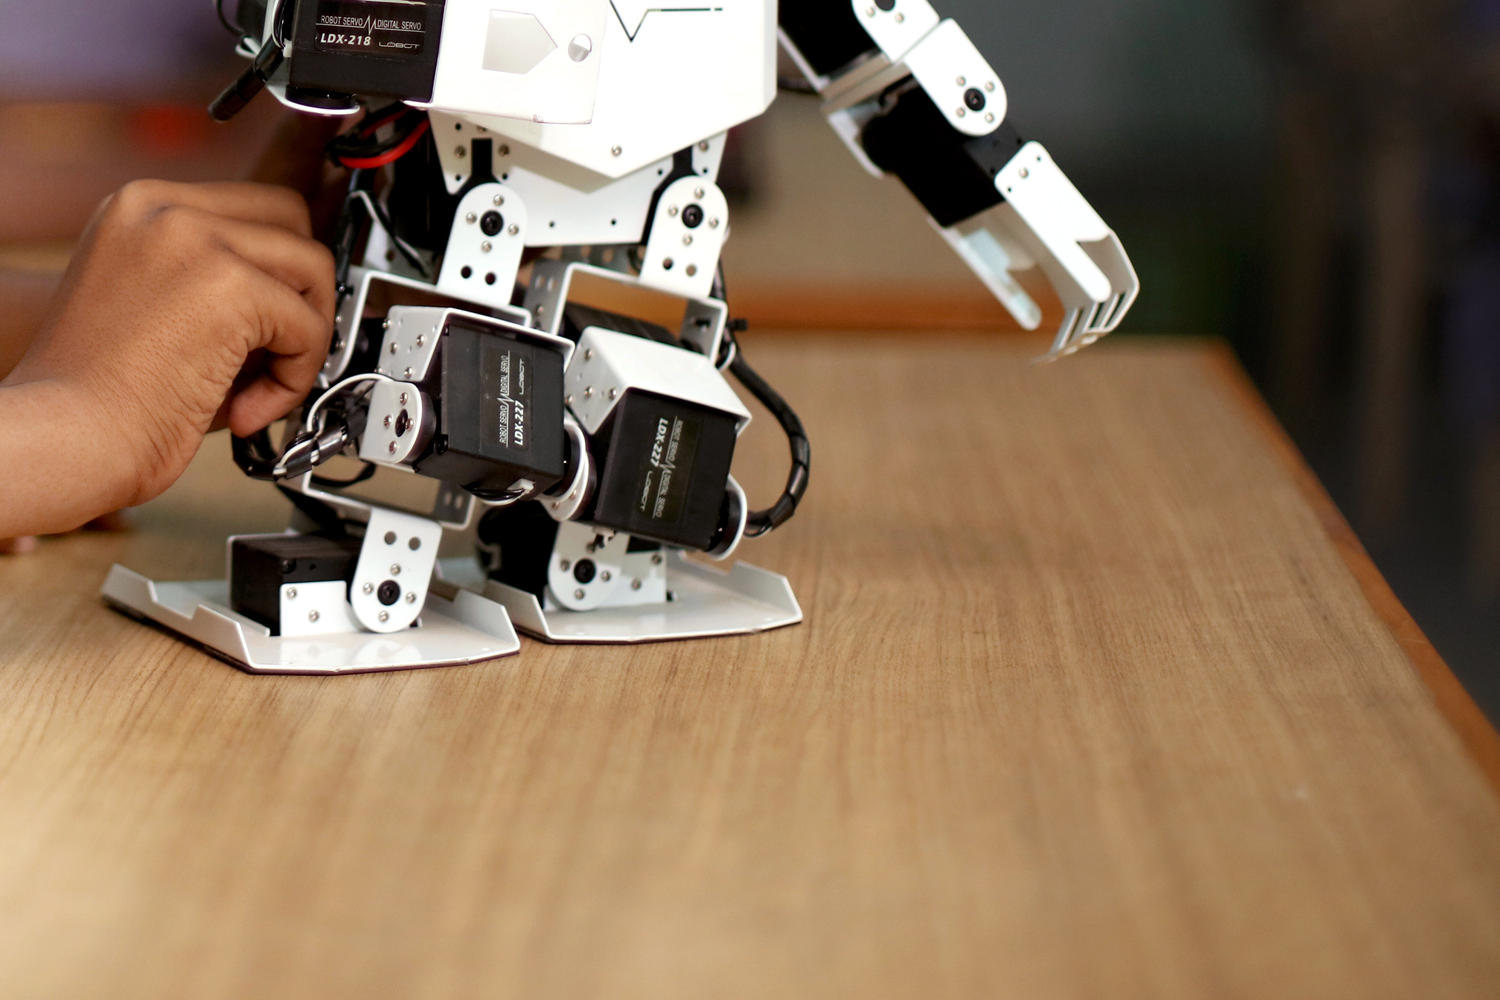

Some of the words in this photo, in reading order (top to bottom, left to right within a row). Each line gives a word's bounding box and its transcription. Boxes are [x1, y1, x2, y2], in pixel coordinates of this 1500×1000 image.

[320, 15, 341, 25] ROBOT
[343, 17, 363, 26] SERVO
[377, 19, 399, 29] DIGITAL
[401, 21, 421, 31] SERVO
[320, 33, 371, 46] LDX-218
[514, 400, 524, 446] LDX-227
[650, 417, 669, 468] LDX-227
